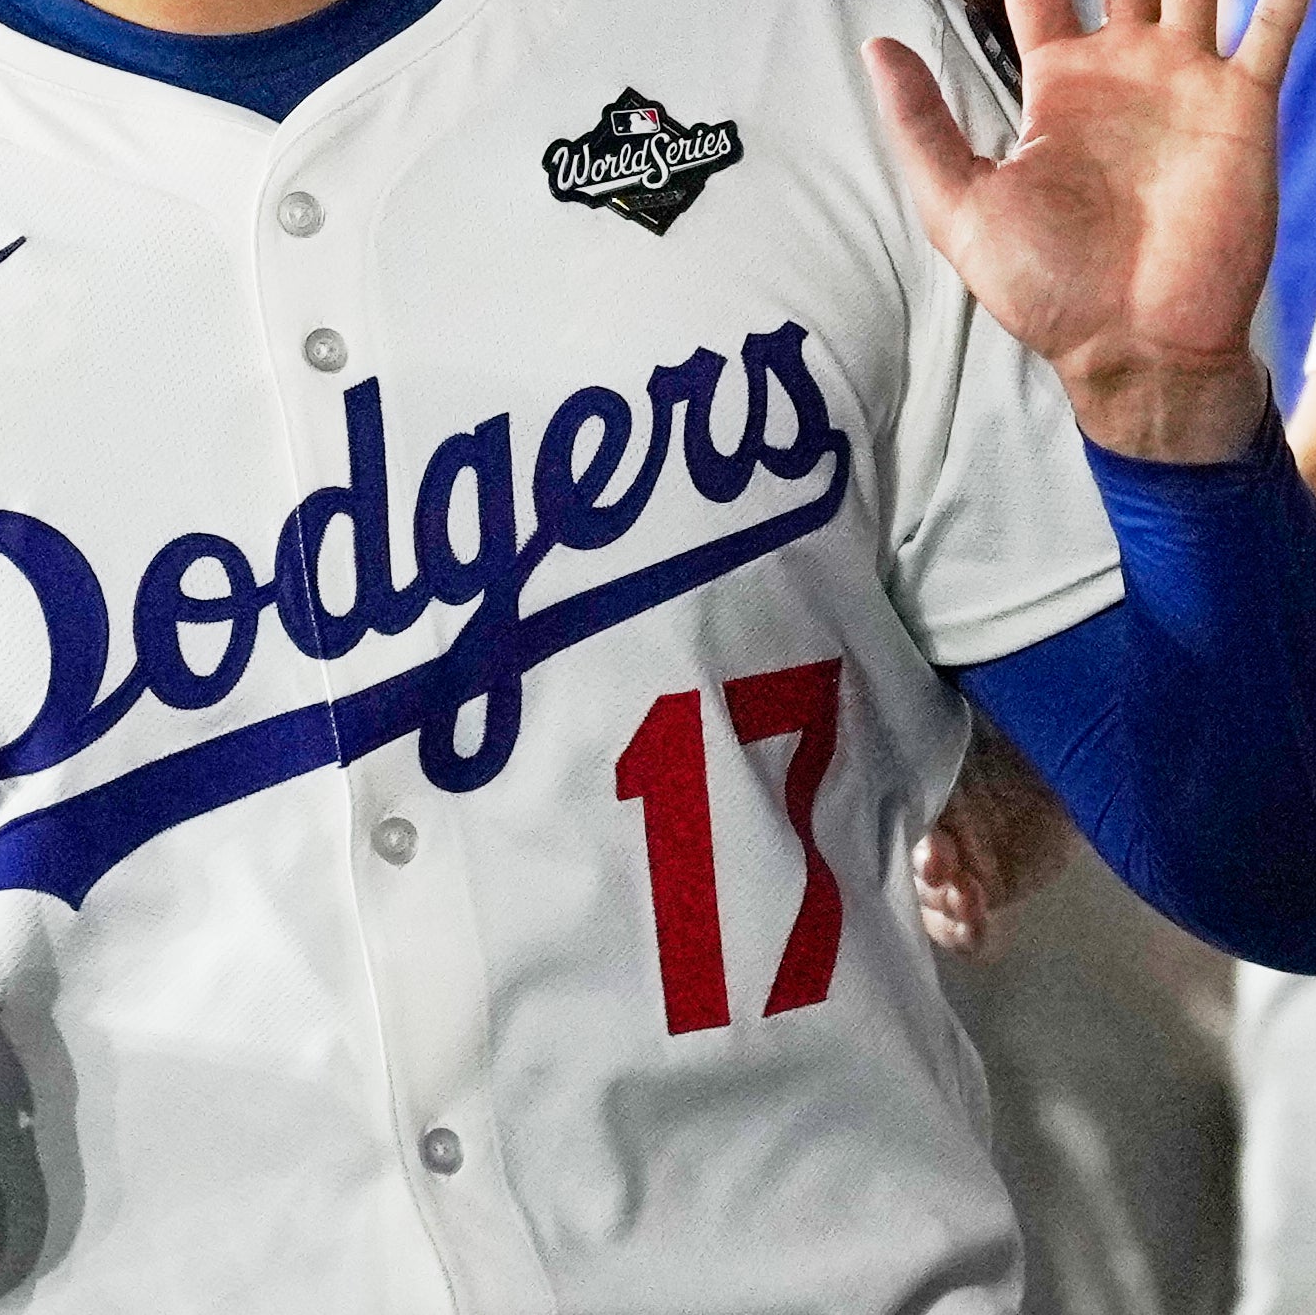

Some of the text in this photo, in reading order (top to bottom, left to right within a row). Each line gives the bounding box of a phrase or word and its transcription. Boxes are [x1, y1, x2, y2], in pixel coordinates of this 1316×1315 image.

[551, 128, 731, 191] World Series
[615, 657, 843, 1036] 17
